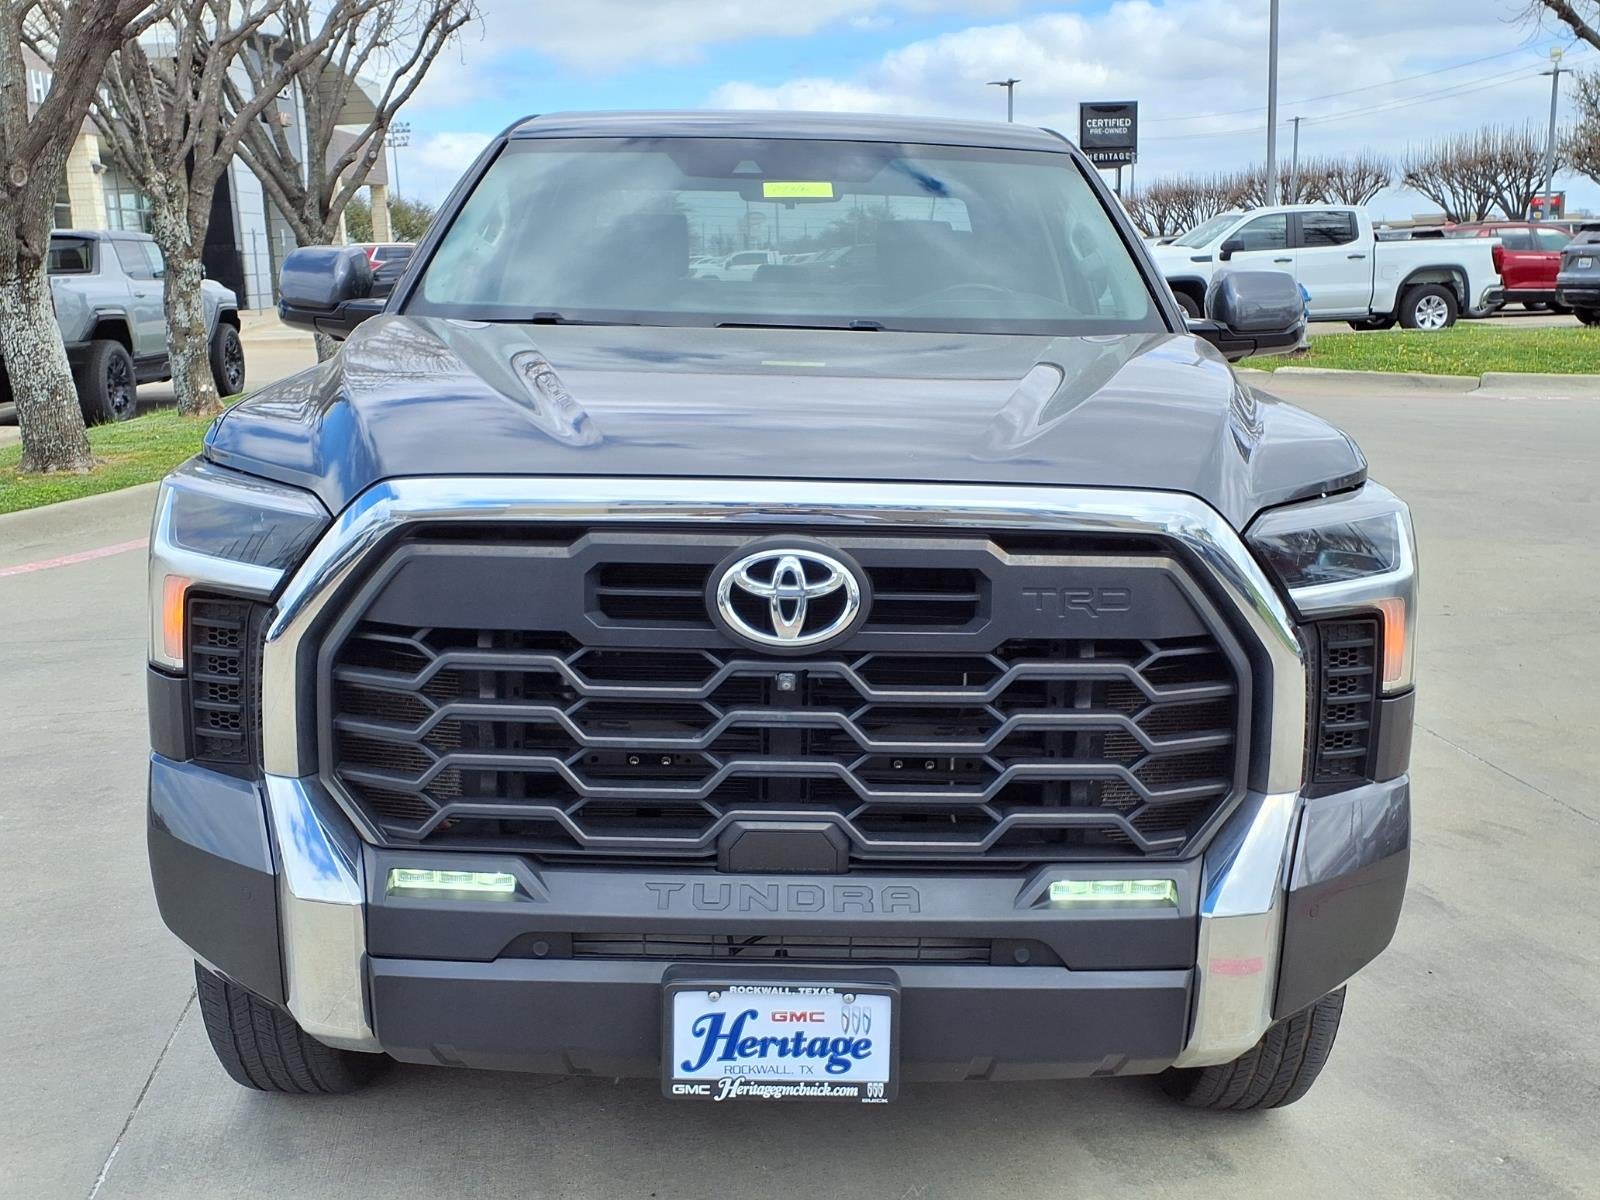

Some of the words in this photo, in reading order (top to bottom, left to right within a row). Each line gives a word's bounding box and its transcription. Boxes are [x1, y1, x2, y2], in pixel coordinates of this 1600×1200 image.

[1086, 118, 1131, 127] CERTIFIED
[1022, 587, 1131, 618] TRD
[645, 882, 920, 913] TUNDRA
[798, 987, 835, 995] TEXAS
[771, 1011, 825, 1023] GMC
[680, 1008, 873, 1075] Heritage
[799, 1065, 814, 1074] TX
[672, 1084, 711, 1095] GMC
[714, 1076, 858, 1101] Heritagegmcbuick.com
